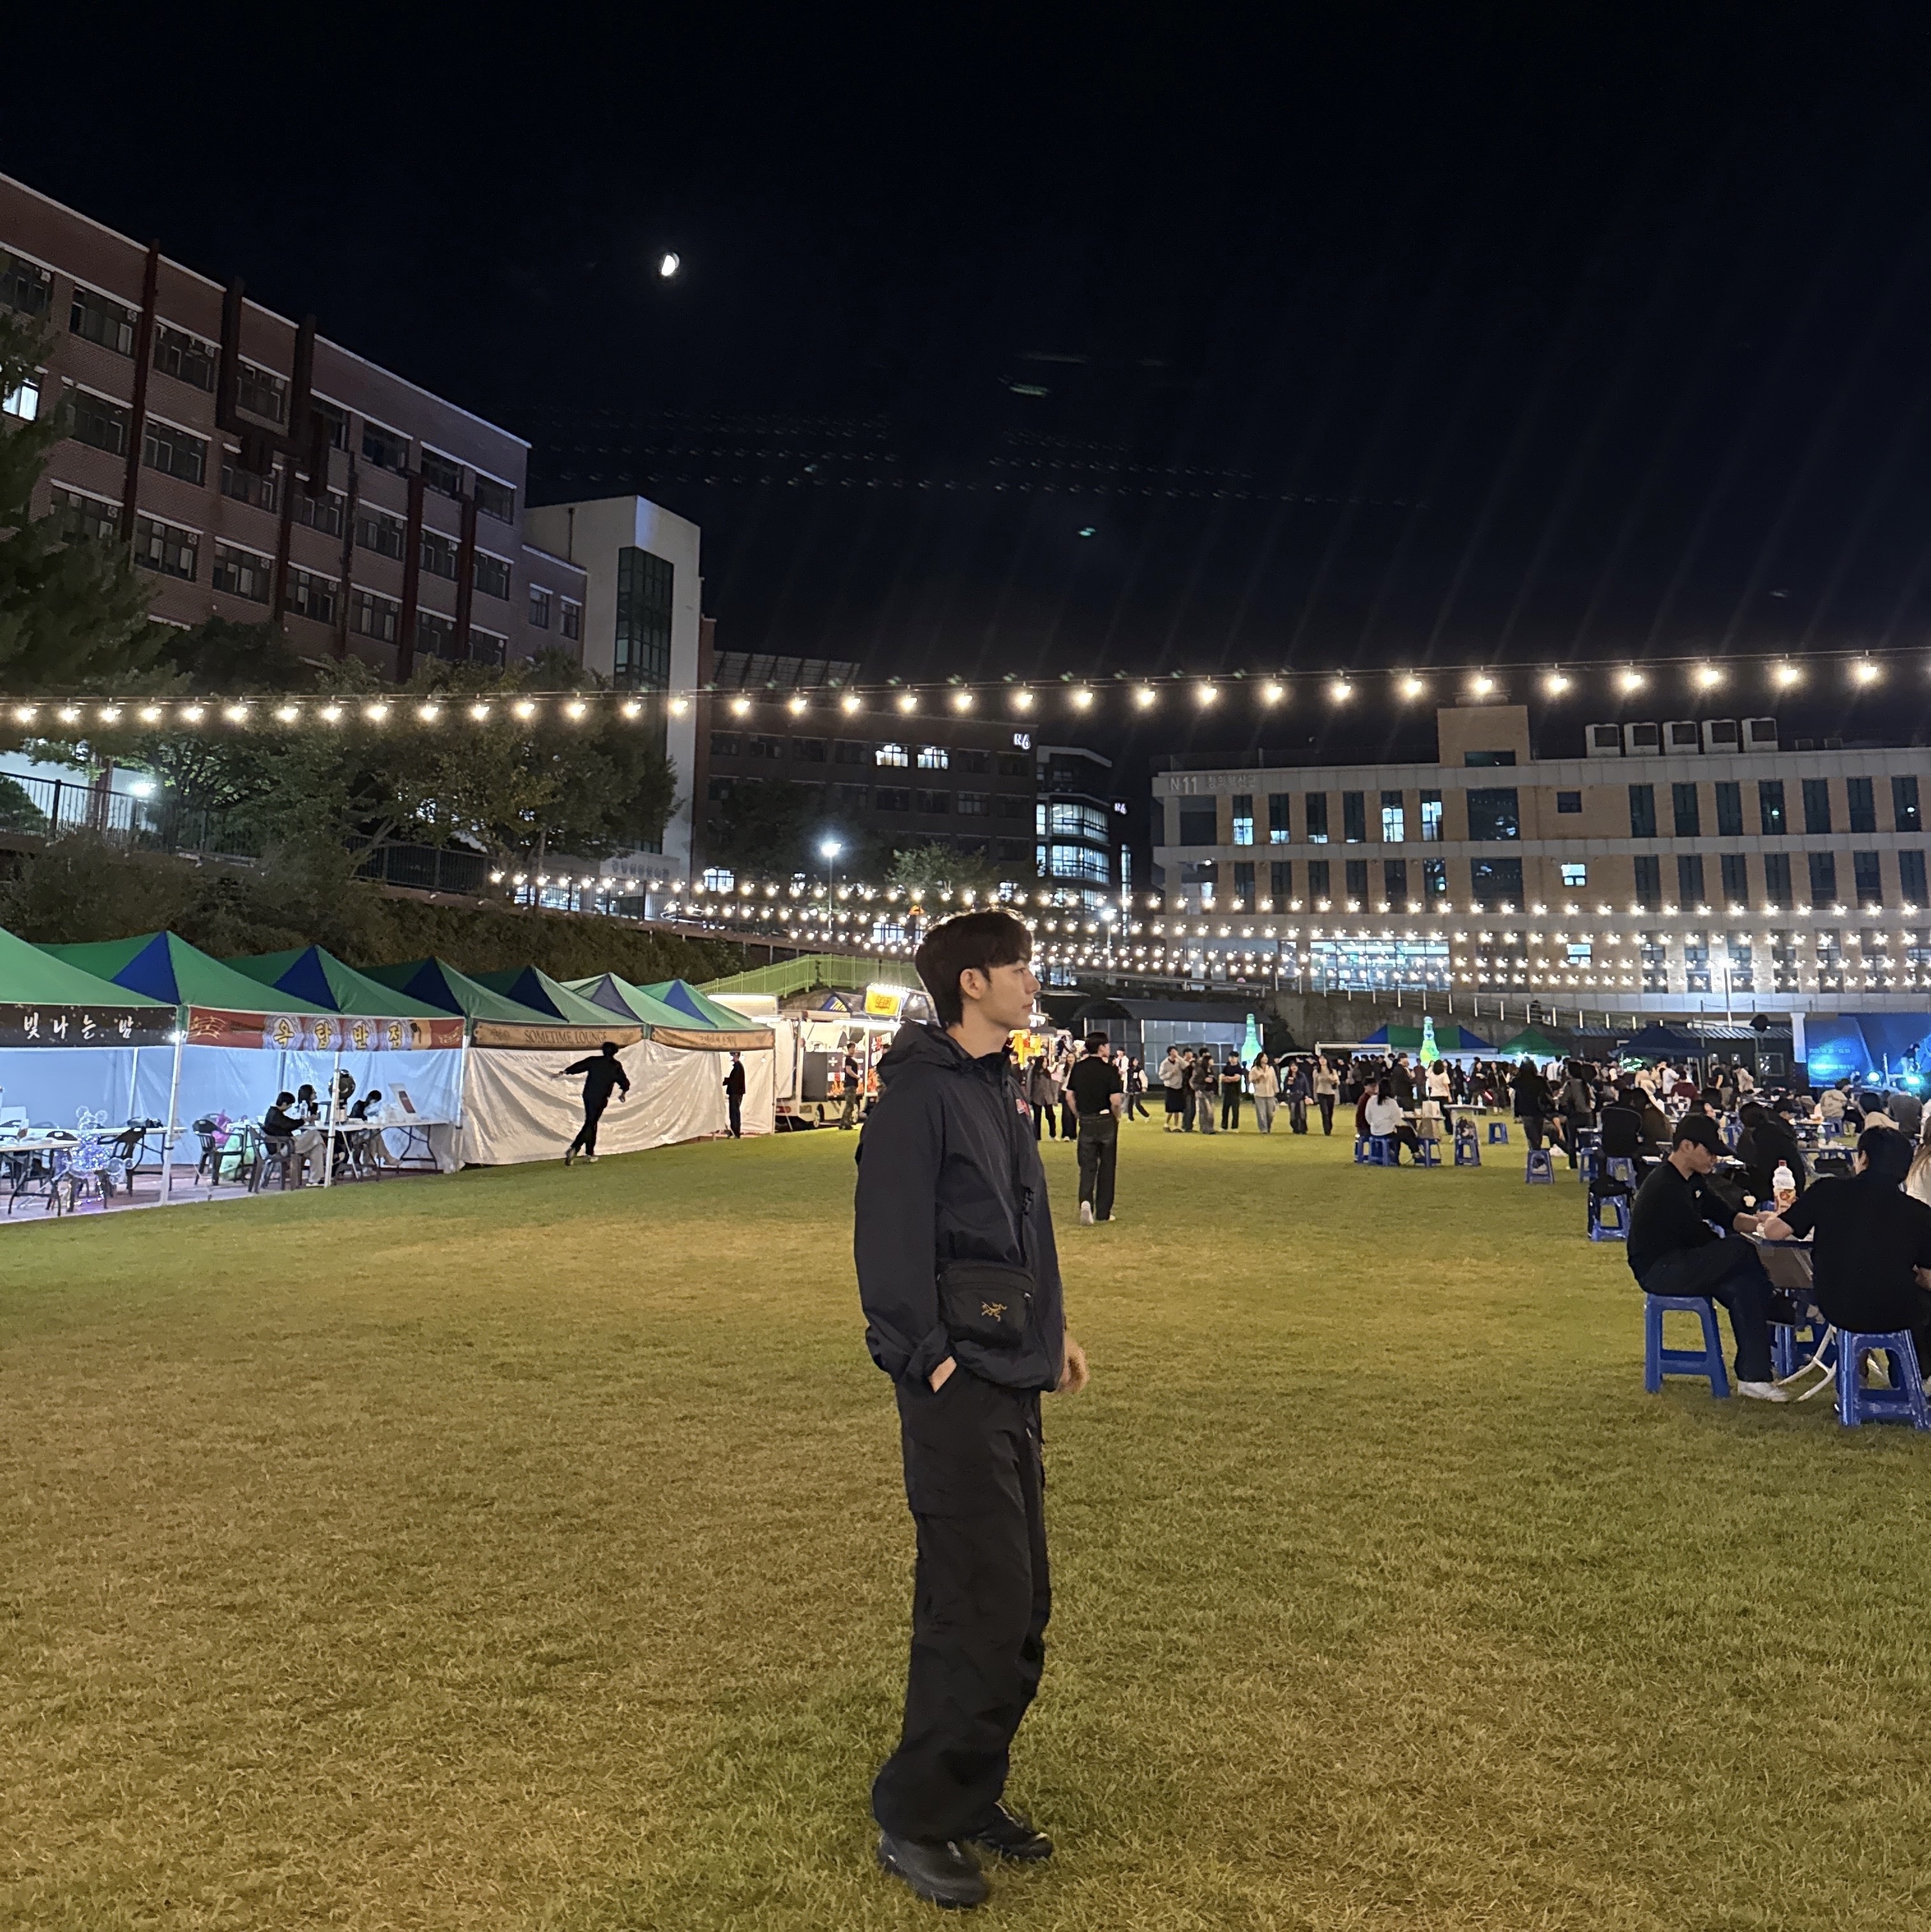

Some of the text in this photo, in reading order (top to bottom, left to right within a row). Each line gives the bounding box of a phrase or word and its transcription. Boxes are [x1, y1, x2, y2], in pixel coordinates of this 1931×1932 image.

[1170, 776, 1197, 795] N11
[118, 1015, 134, 1039] 밤
[524, 1029, 607, 1044] SOMETIME LOUNGE
